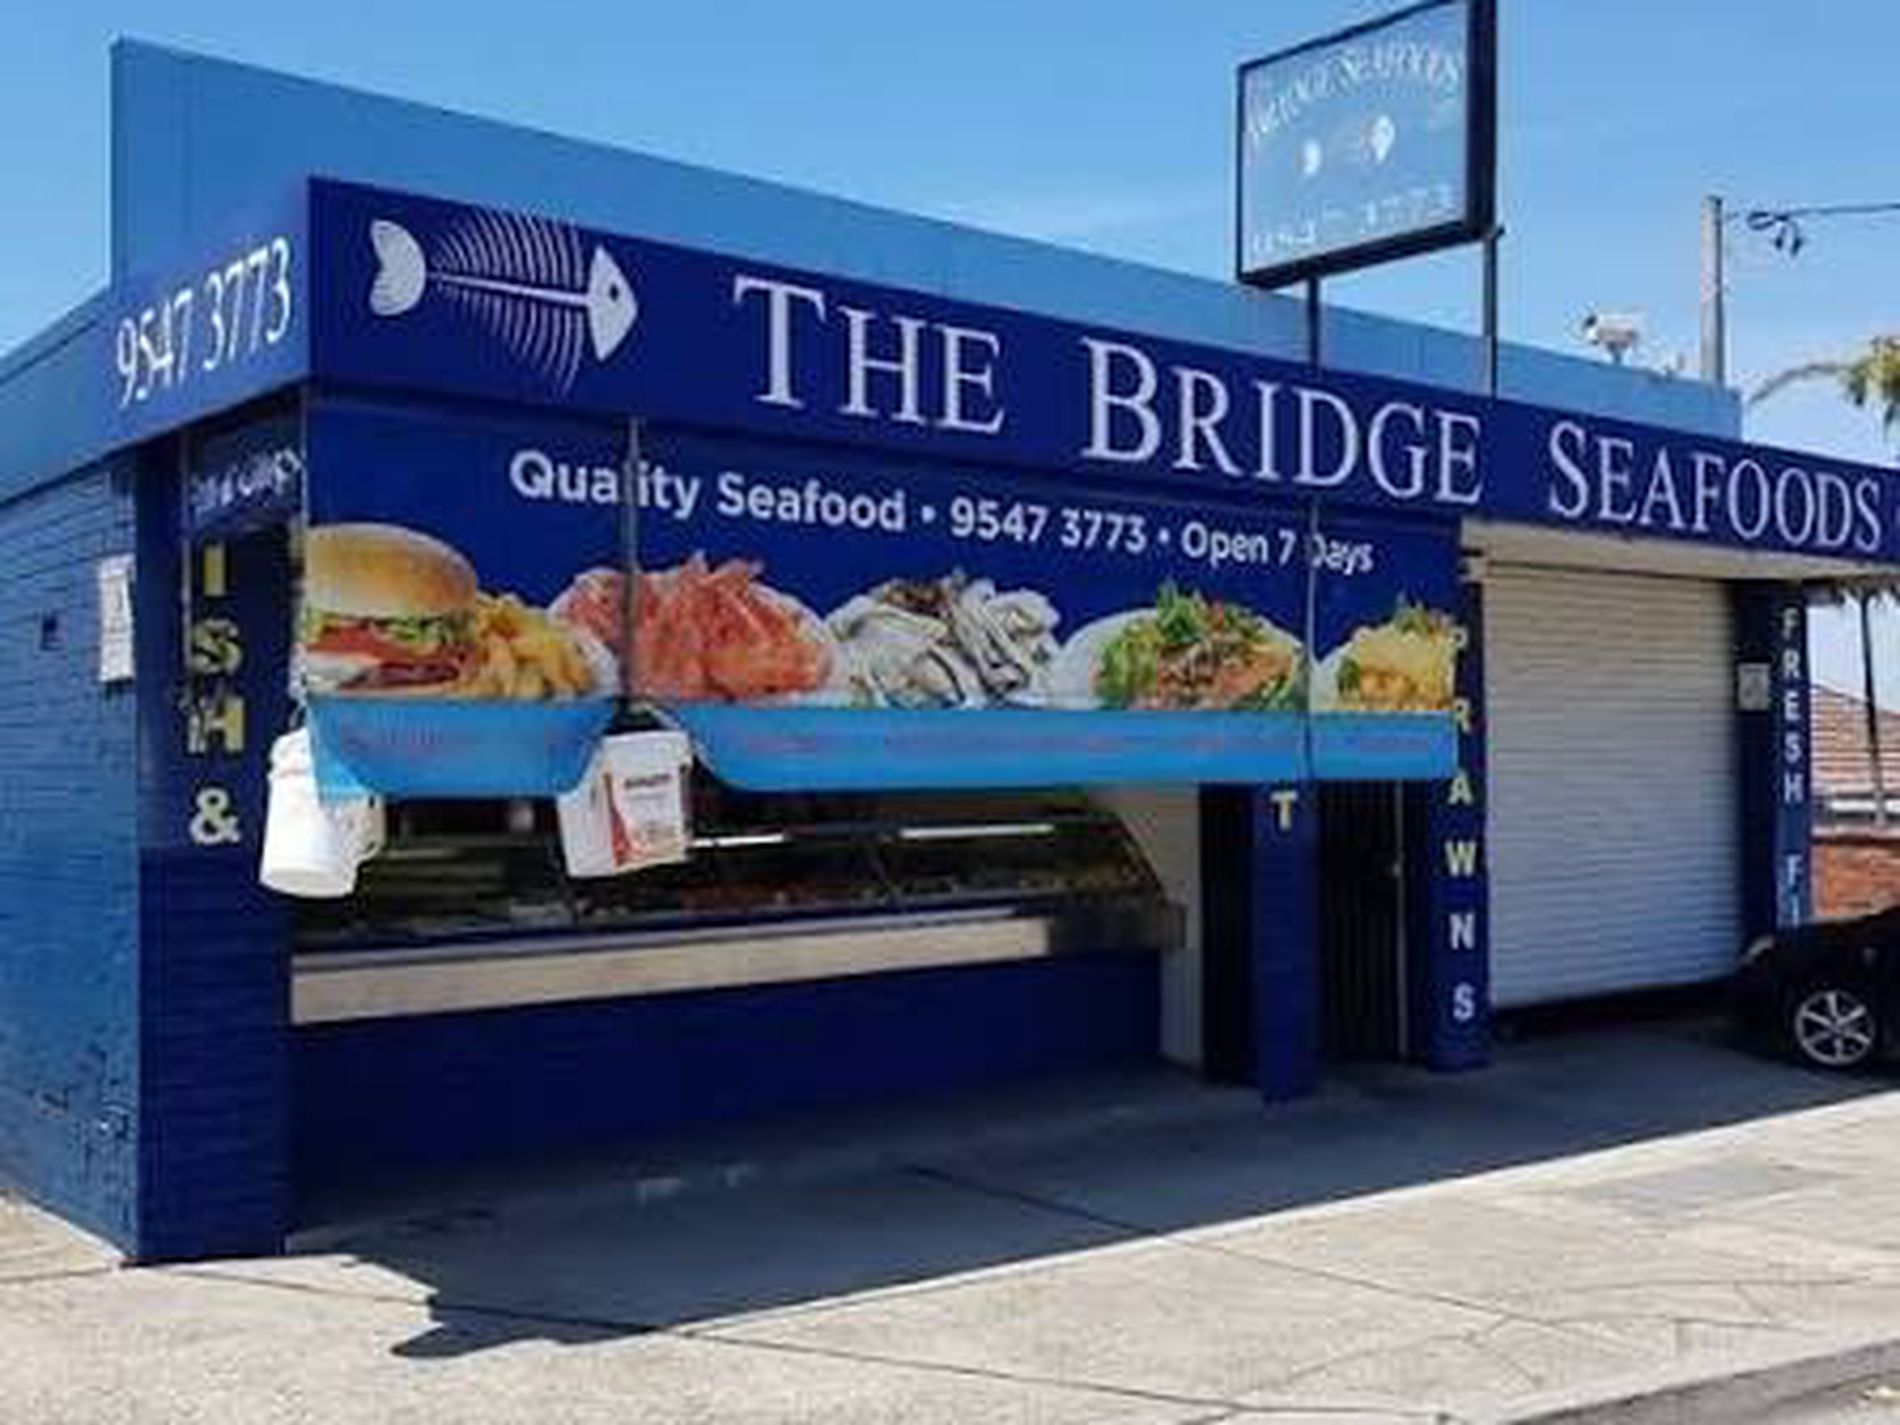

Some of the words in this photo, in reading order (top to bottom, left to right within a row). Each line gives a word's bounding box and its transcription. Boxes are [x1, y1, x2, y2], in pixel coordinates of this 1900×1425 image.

[117, 288, 193, 410] 9547
[203, 236, 290, 371] 3773
[733, 274, 1004, 435] THE
[1081, 336, 1482, 506] BRIDGE
[1549, 420, 1882, 552] SEAFOODS
[509, 450, 701, 519] Quaity
[716, 471, 907, 532] Seafood
[950, 496, 1049, 543] 9547
[1060, 508, 1147, 554] 3773
[1180, 520, 1269, 567] Open
[1279, 530, 1295, 566] 7
[1782, 607, 1803, 804] FRESH
[189, 787, 242, 844] &
[1446, 625, 1477, 1021] PRAWNS
